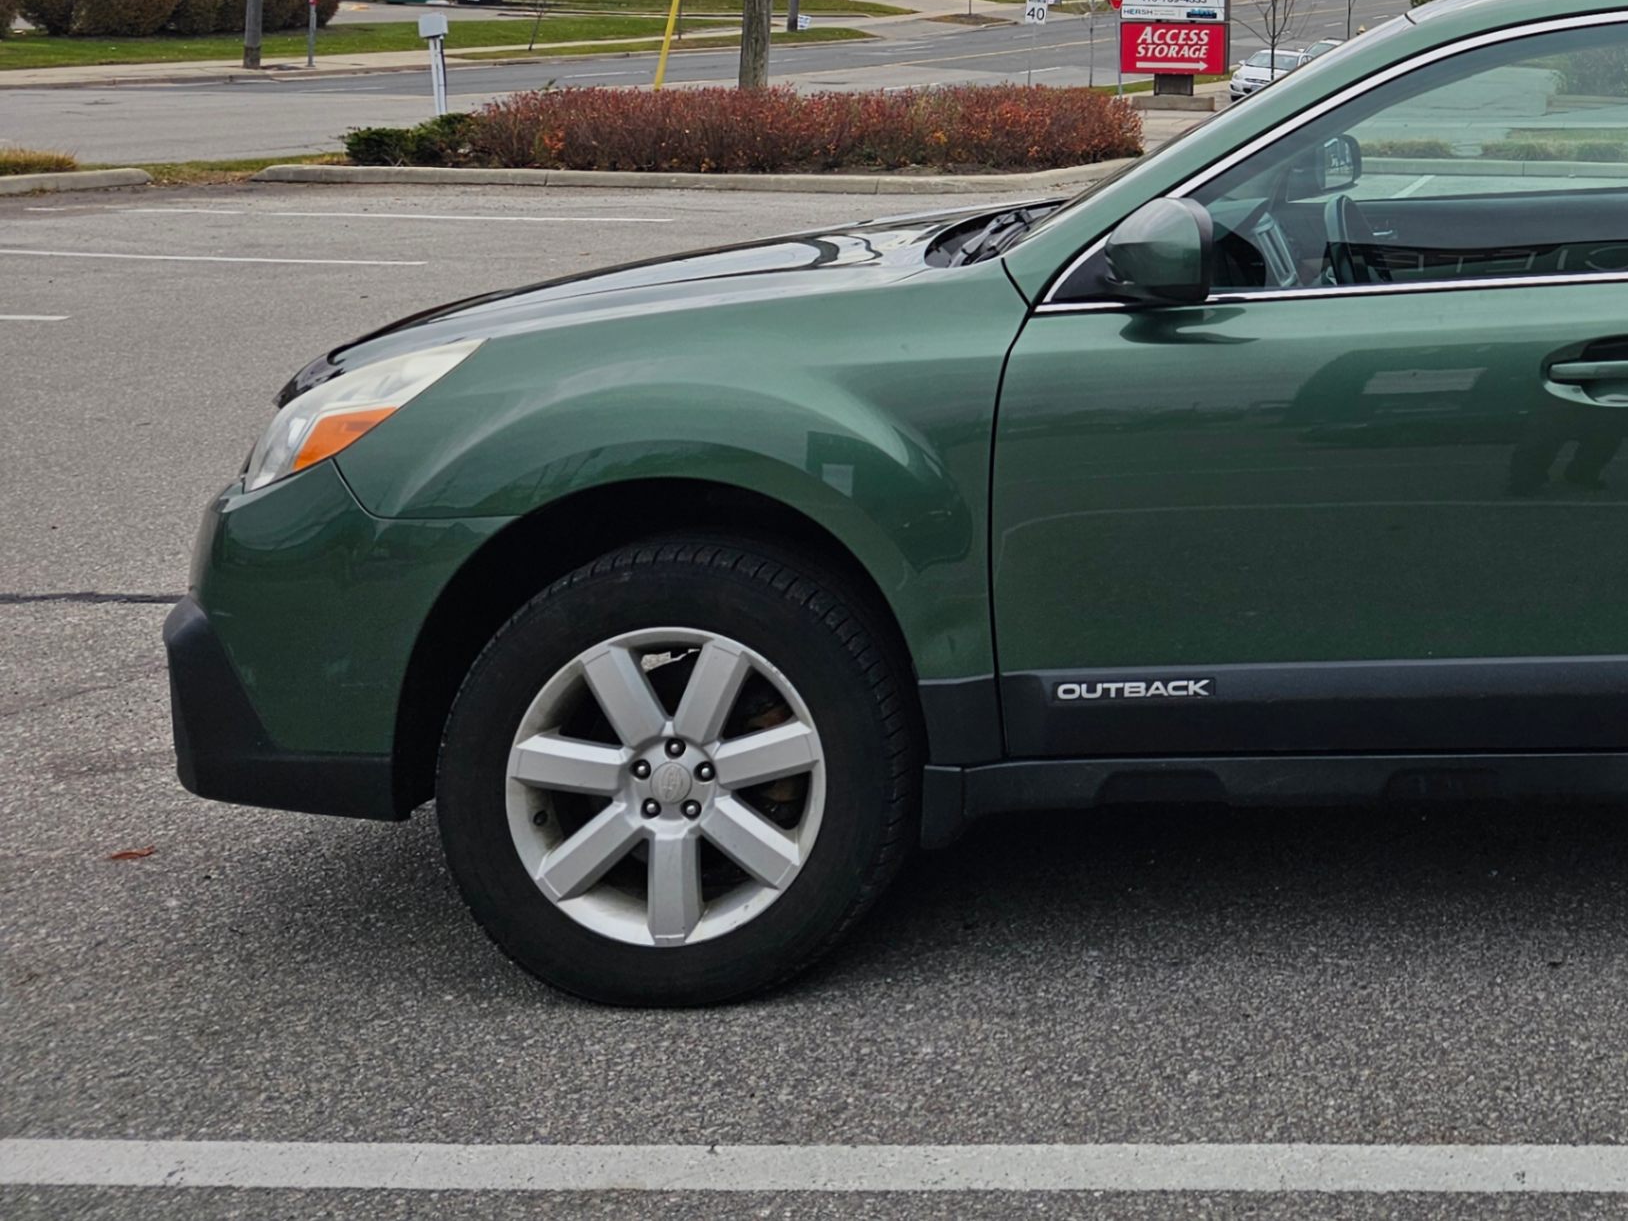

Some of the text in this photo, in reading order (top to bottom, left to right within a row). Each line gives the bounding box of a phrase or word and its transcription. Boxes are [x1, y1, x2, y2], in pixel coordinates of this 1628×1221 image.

[1027, 7, 1045, 21] 40
[1136, 26, 1210, 45] ACCESS
[1136, 44, 1209, 58] STORAGE
[1057, 679, 1210, 700] OUTBACK
